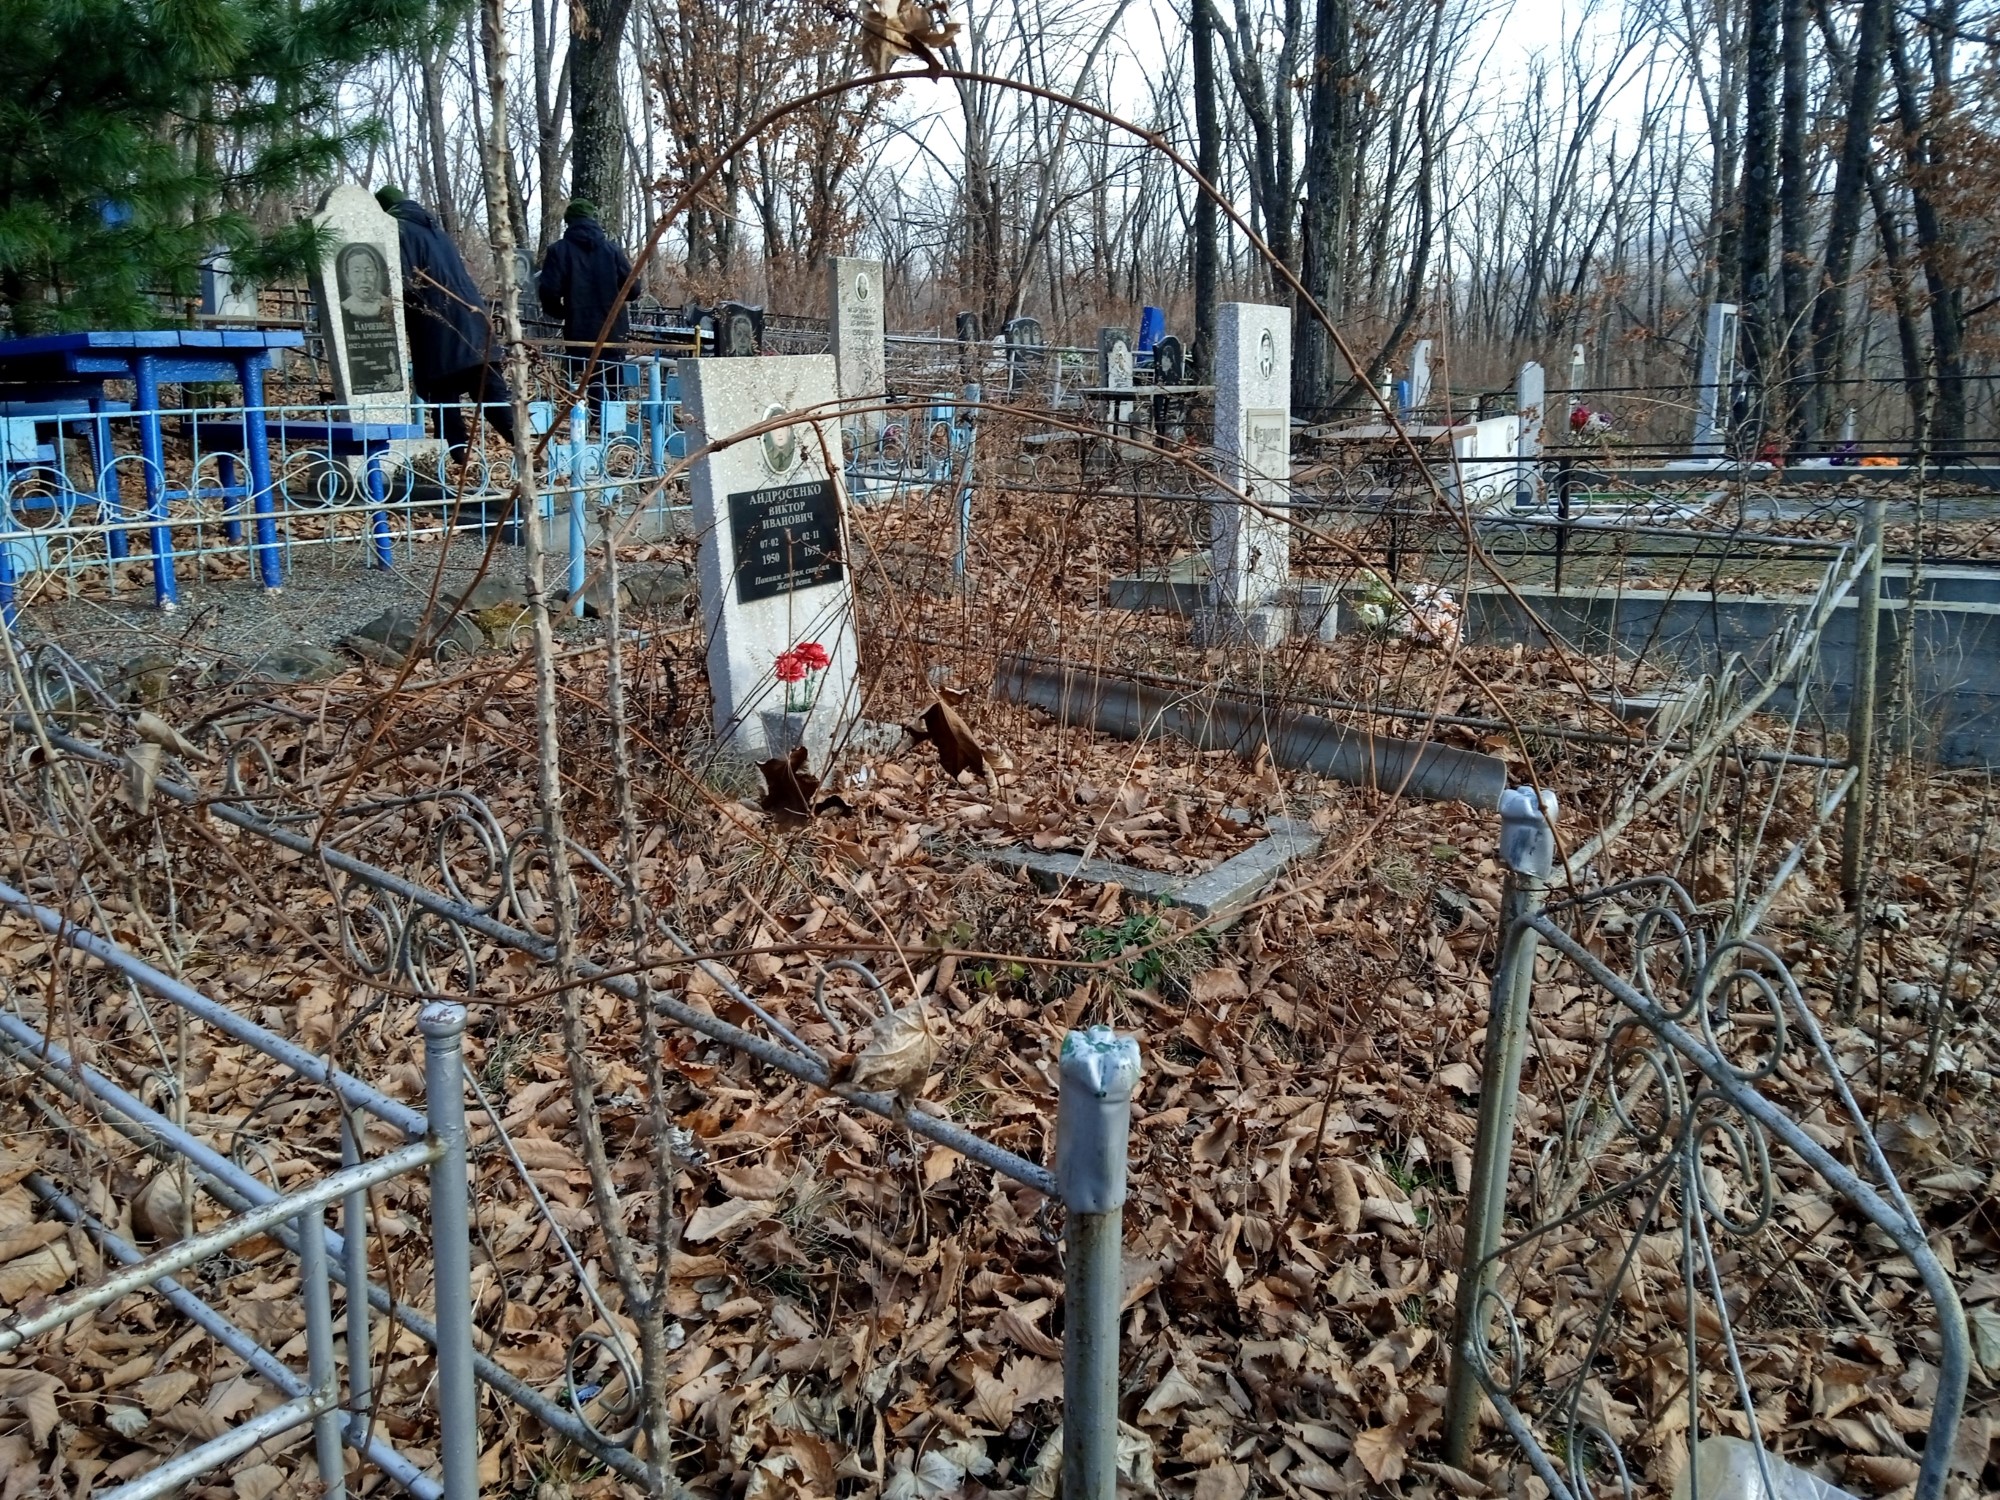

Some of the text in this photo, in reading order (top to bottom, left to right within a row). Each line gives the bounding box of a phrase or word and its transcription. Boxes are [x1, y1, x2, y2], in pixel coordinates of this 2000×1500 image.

[749, 484, 822, 505] АНДРОСЕНКО
[768, 501, 806, 516] ВИКТОР
[762, 512, 814, 530] ИВАНОВИЧ
[762, 552, 780, 565] 1950
